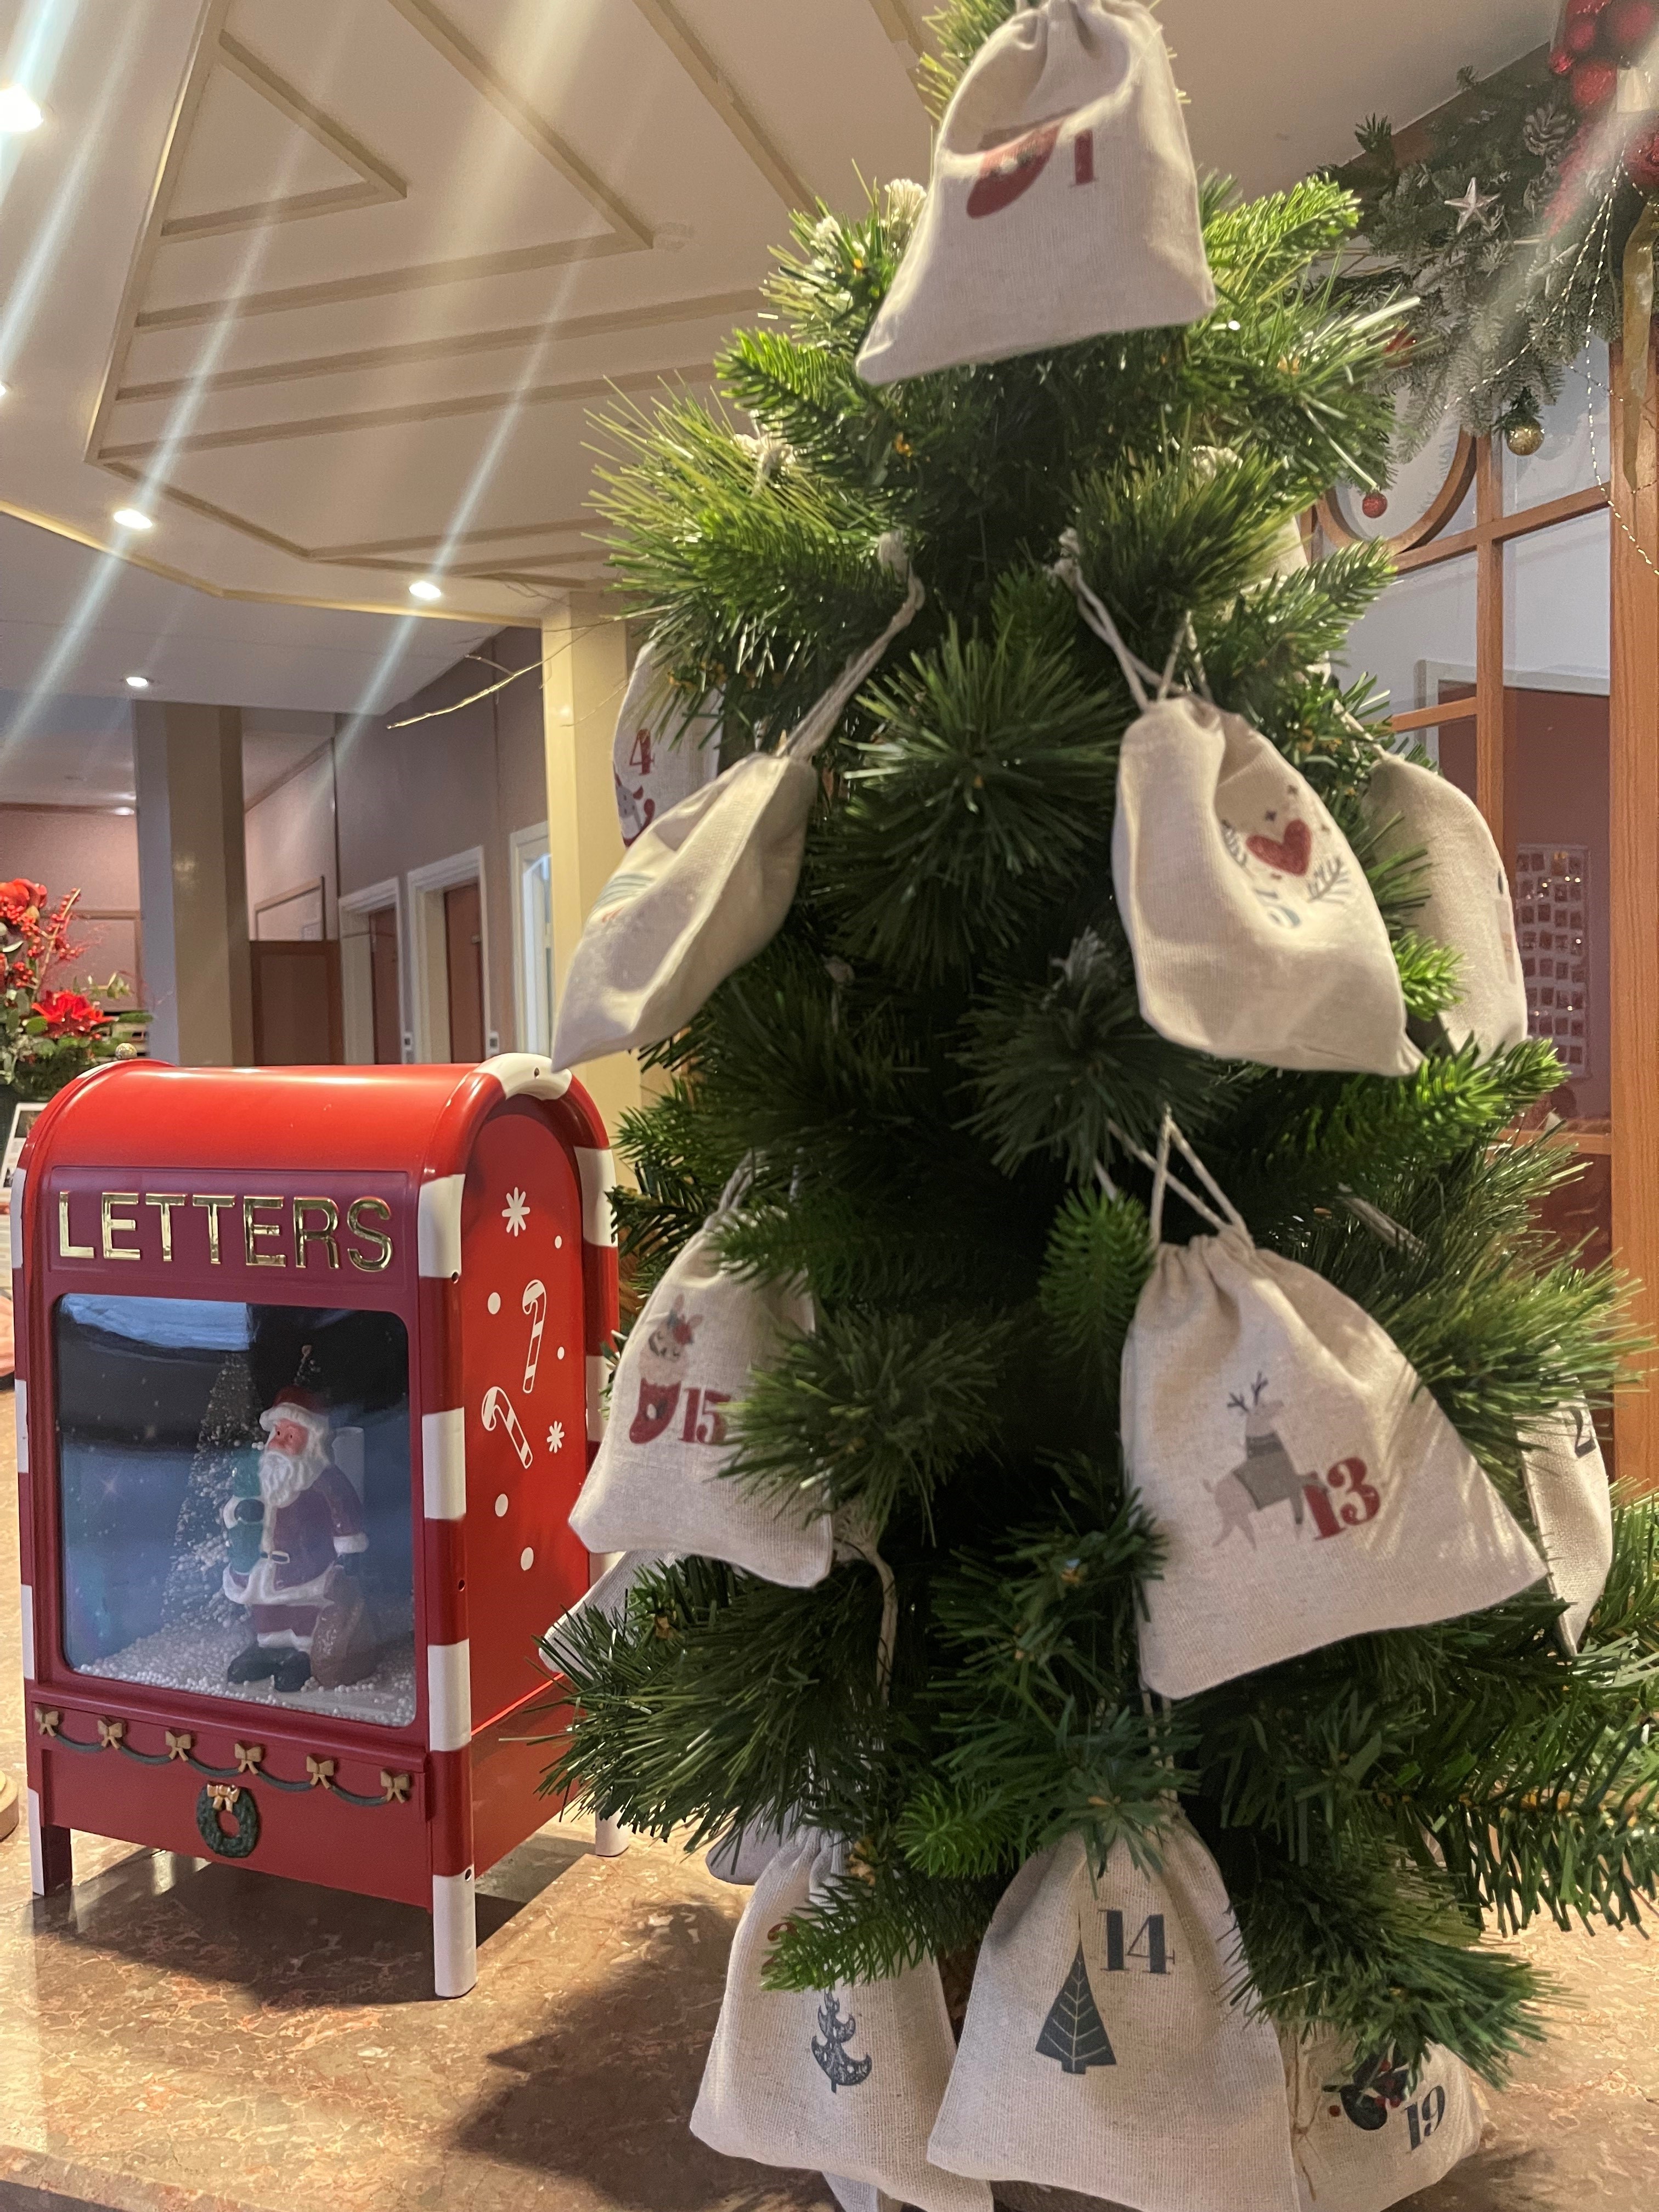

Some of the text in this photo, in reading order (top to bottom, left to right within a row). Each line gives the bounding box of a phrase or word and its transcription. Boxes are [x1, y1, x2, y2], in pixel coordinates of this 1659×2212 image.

[1069, 128, 1099, 187] 1
[629, 728, 655, 776] 4
[58, 1190, 393, 1273] LETTERS
[678, 1387, 731, 1446] 15
[1301, 1457, 1380, 1541] 13
[1097, 1907, 1175, 1974] 14
[1401, 2085, 1446, 2154] 19
